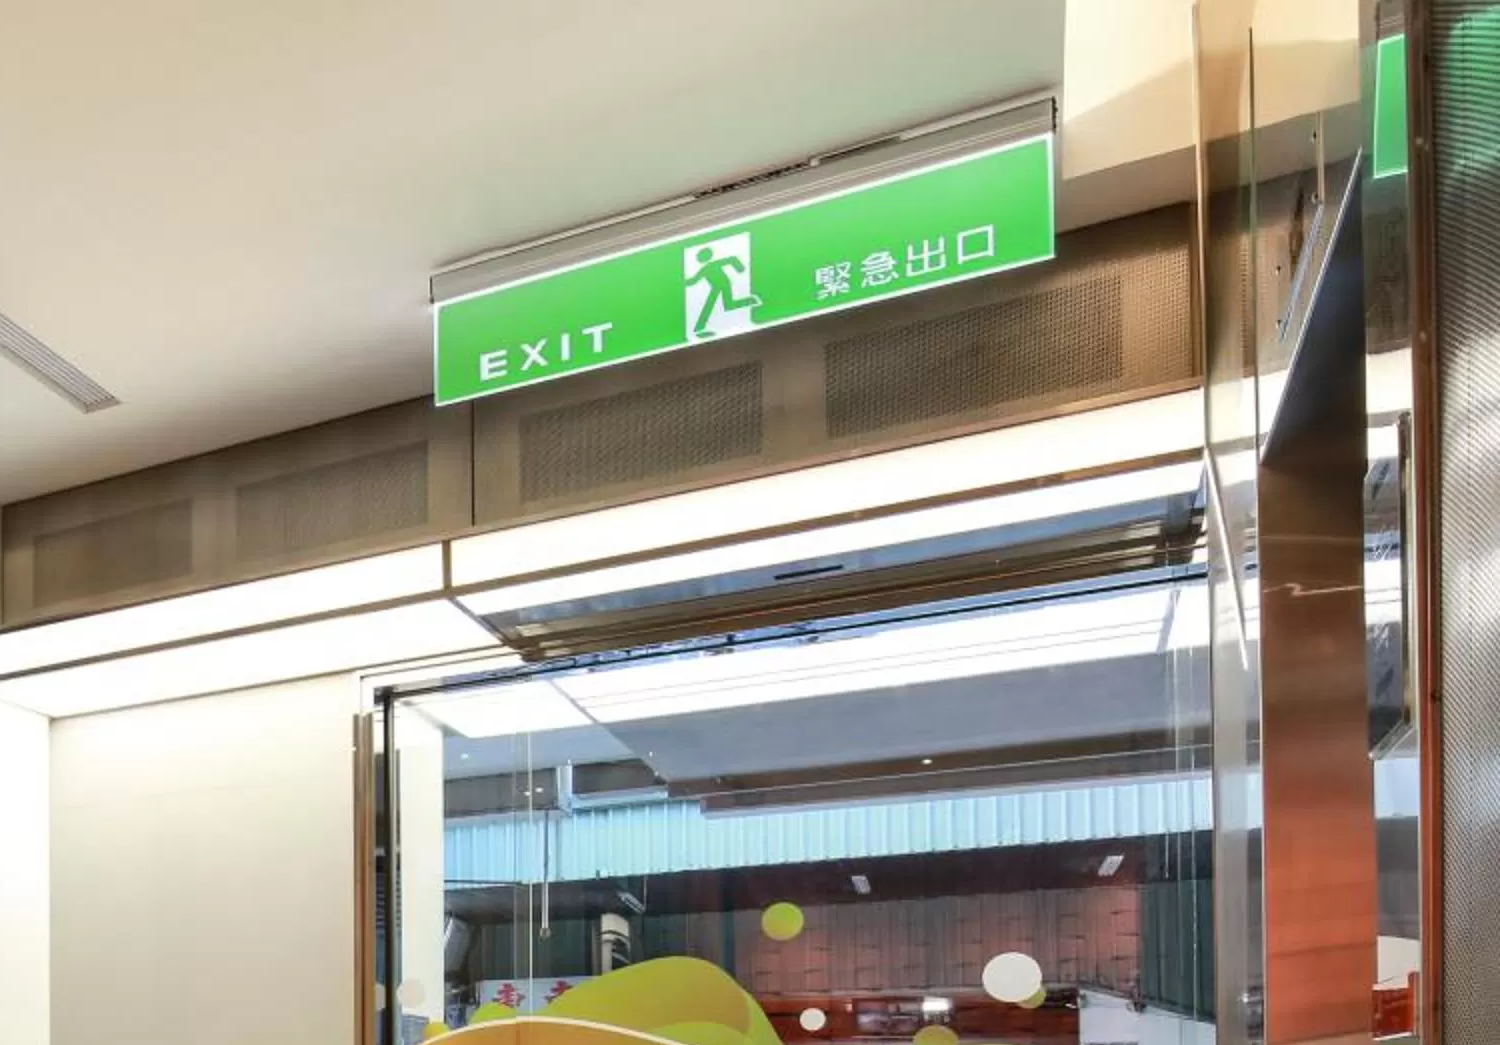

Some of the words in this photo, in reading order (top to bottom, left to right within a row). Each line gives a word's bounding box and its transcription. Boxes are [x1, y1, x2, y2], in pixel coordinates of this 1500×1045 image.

[815, 223, 995, 301] 緊急出口
[479, 322, 613, 381] EXIT
